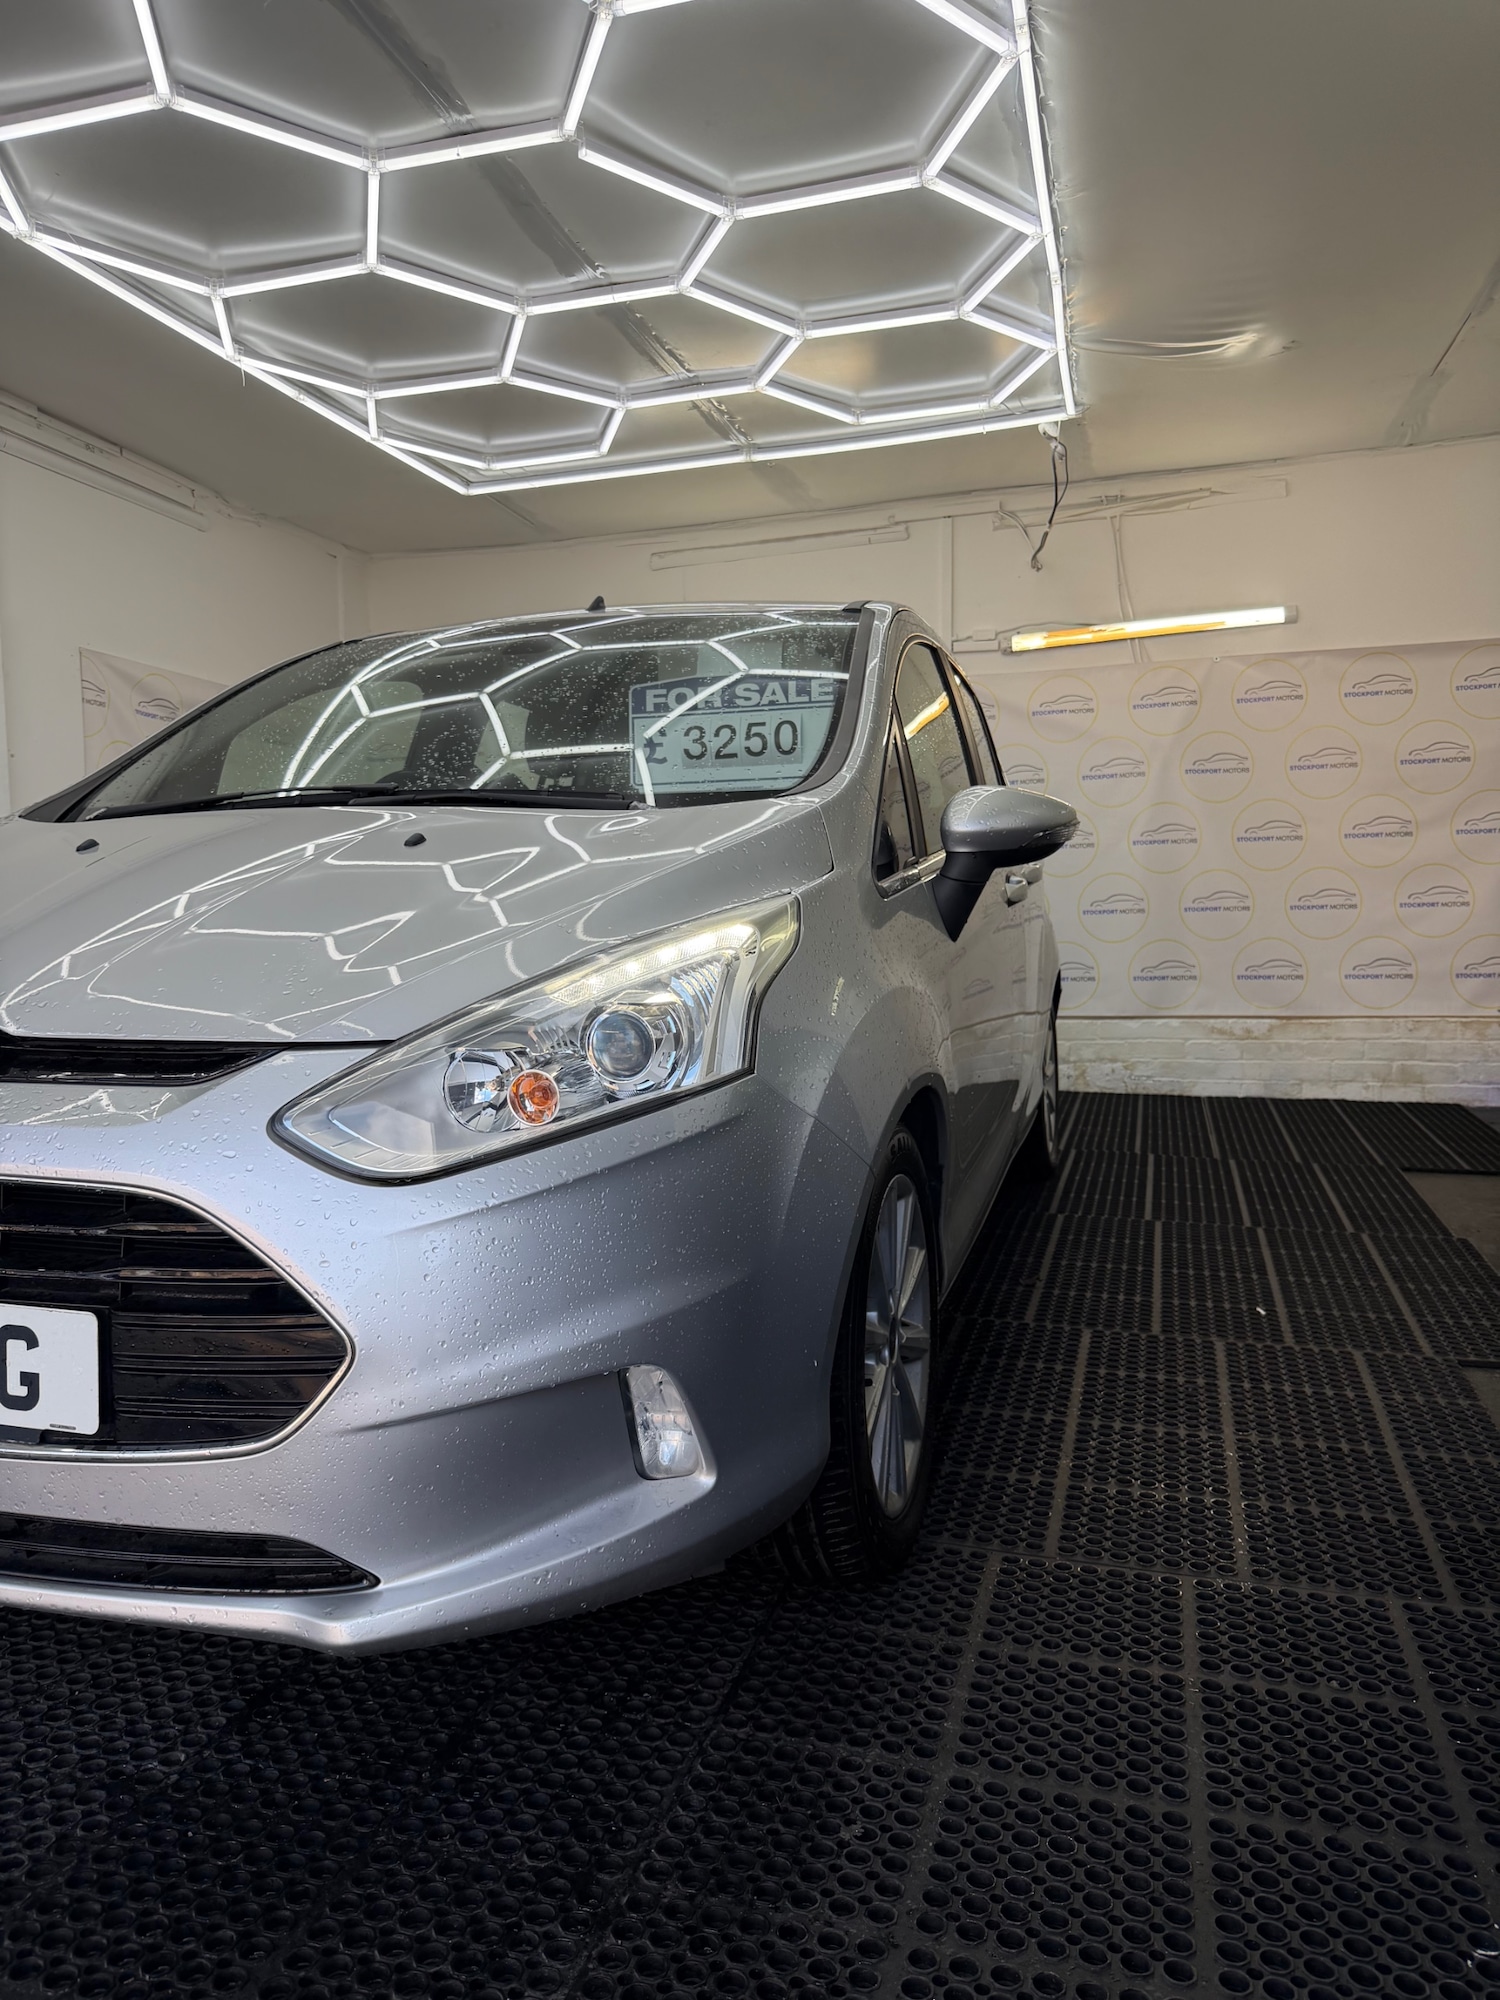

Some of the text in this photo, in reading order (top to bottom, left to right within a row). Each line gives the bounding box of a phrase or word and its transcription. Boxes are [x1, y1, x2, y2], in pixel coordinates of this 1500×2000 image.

[1456, 683, 1497, 692] STOCKPORT
[646, 679, 834, 711] FOR SALE
[1236, 694, 1303, 704] STOCKPORT MOTORS
[1132, 700, 1197, 710] STOCKPORT MOTORS
[1031, 707, 1094, 717] STOCKPORT MOTORS
[683, 720, 798, 761] 3250
[1400, 756, 1471, 766] STOCKPORT MOTORS
[1222, 767, 1250, 775] MOTORS
[1289, 764, 1328, 772] STOCKPORT
[1082, 772, 1145, 782] STOCKPORT MOTORS
[1343, 830, 1413, 840] STOCKPORT MOTORS
[1456, 828, 1497, 836] STOCKPORT
[1170, 837, 1197, 845] MOTORS
[1275, 834, 1303, 842] MOTORS
[1329, 902, 1358, 910] MOTORS
[1399, 901, 1440, 909] STOCKPORT
[1082, 907, 1145, 916] STOCKPORT MOTORS
[1170, 974, 1197, 982] MOTORS
[1236, 973, 1304, 981] STOCKPORT MOTORS
[1384, 972, 1413, 980] MOTORS
